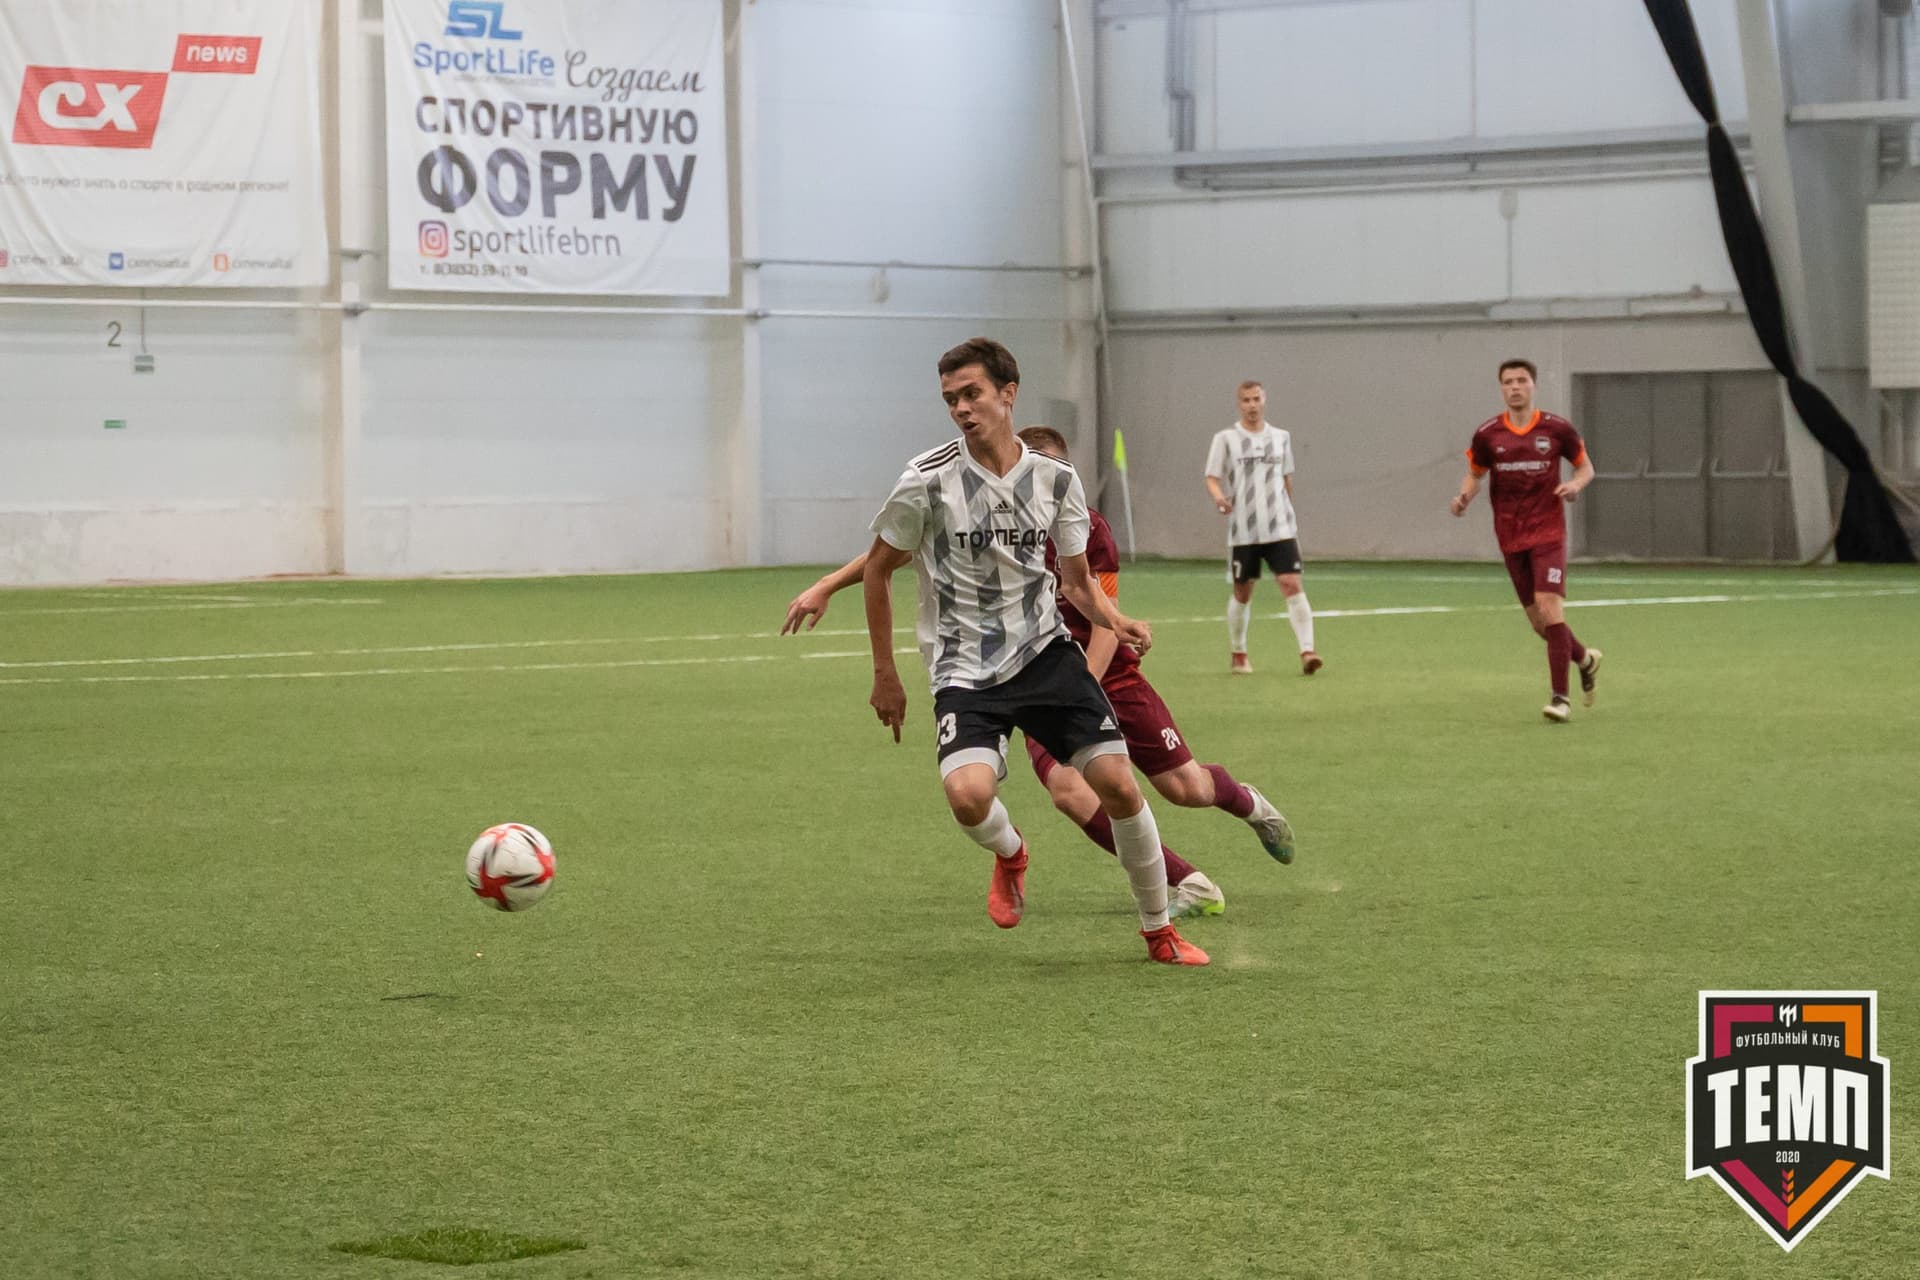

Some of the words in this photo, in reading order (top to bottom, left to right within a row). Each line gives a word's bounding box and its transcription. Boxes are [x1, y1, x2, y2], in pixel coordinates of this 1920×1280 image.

[444, 0, 523, 40] SL
[186, 44, 249, 63] news
[413, 43, 556, 76] SportLife
[564, 49, 706, 103] Создаем
[416, 96, 699, 145] СПОРТИВНУЮ
[417, 144, 698, 223] ФОРМУ
[453, 226, 622, 258] sportlifebrn
[107, 320, 121, 347] 2
[955, 529, 1047, 549] ТОРПЕДО
[1160, 727, 1181, 751] 24
